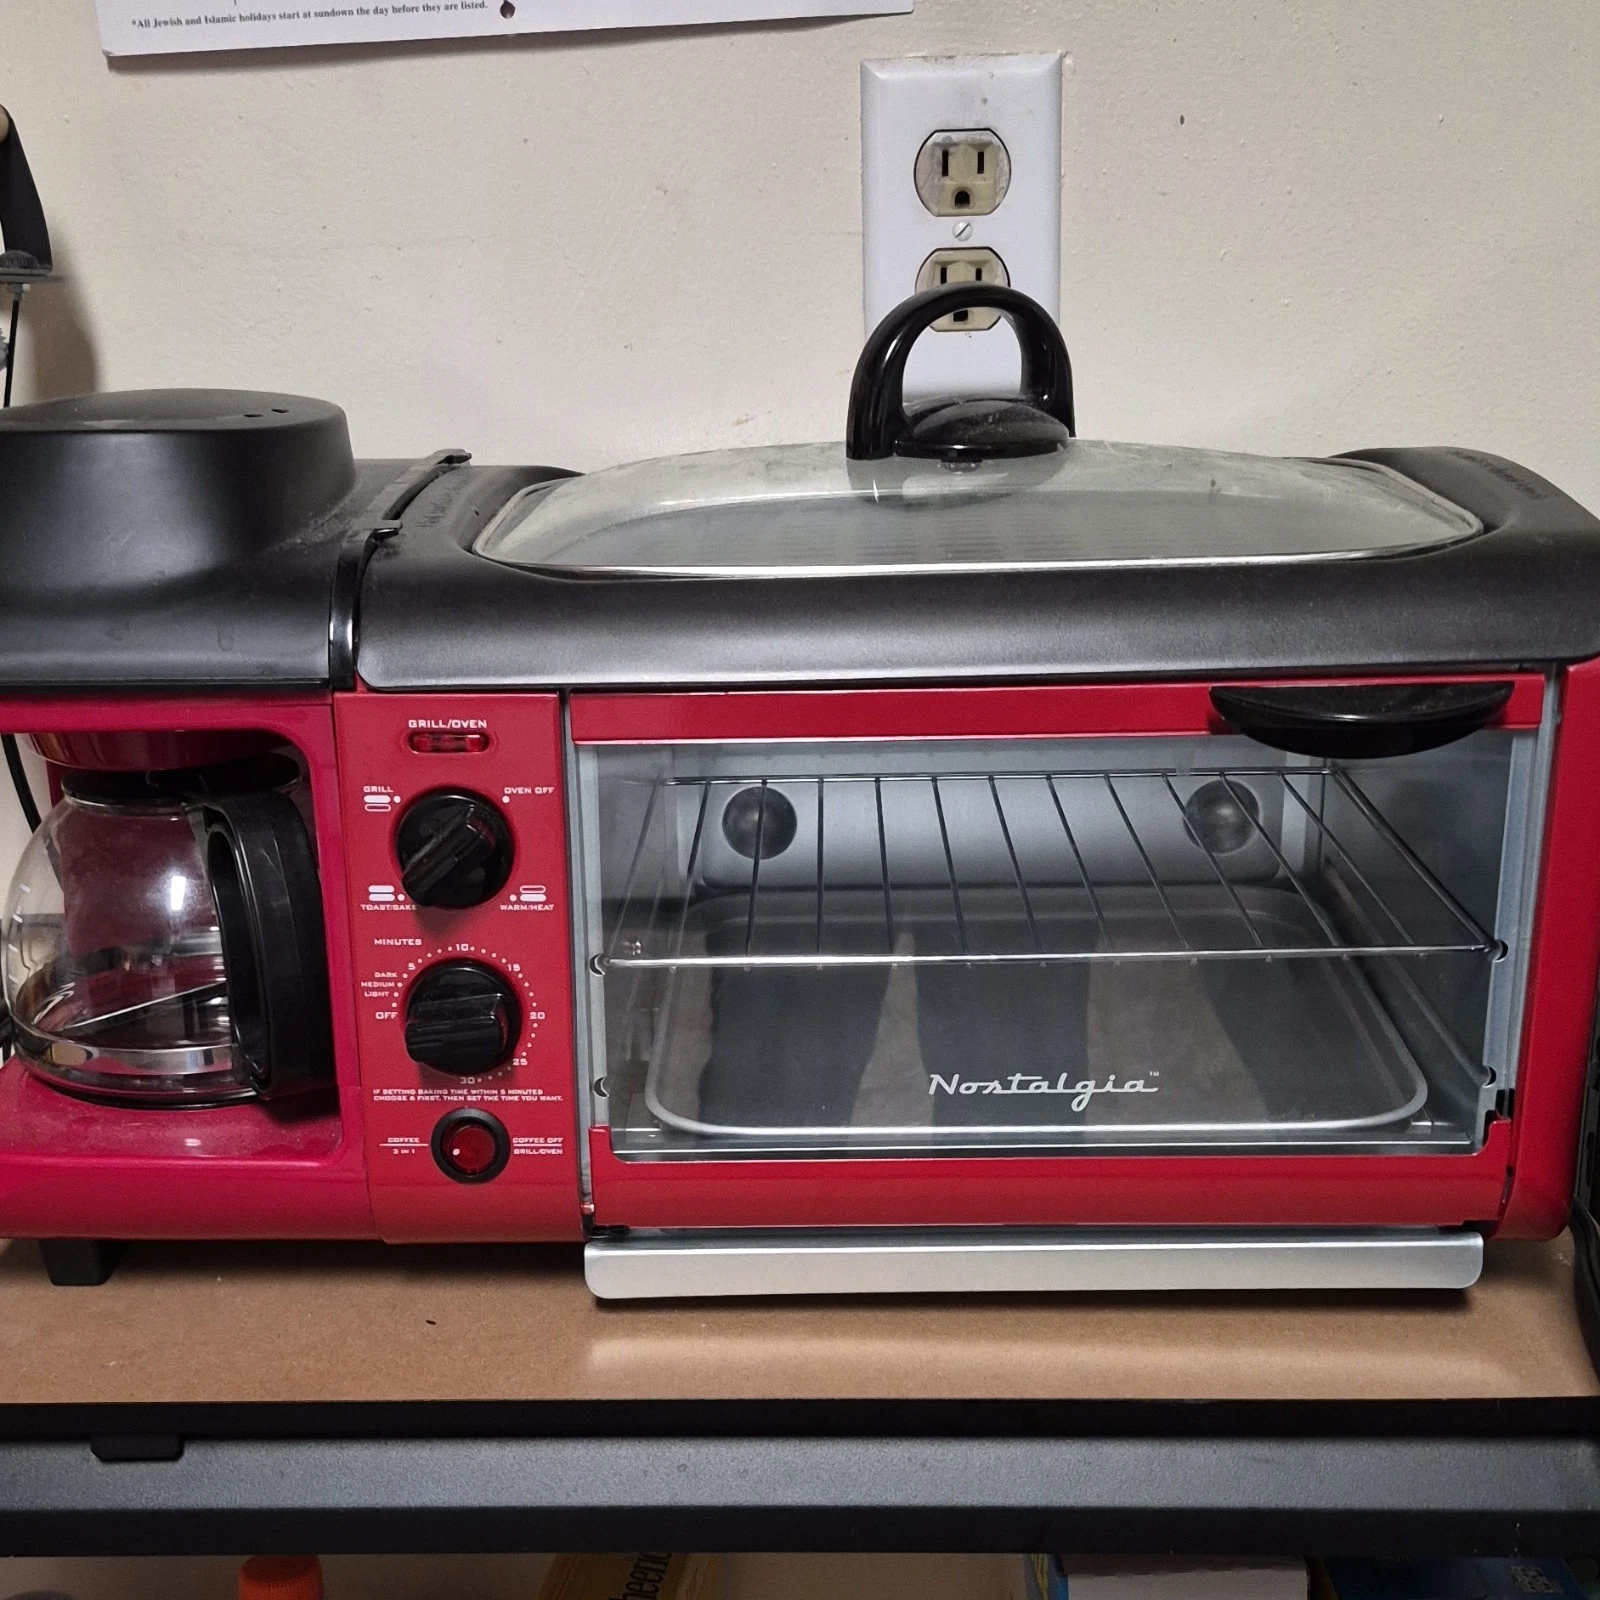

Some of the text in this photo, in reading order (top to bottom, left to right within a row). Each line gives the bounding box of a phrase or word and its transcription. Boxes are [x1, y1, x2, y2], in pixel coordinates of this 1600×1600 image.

[153, 17, 183, 28] Jewish
[185, 15, 202, 26] and
[204, 14, 237, 24] Islamic
[239, 12, 277, 23] holidays
[278, 11, 300, 20] start
[302, 11, 311, 19] at
[313, 8, 354, 18] sundown
[356, 6, 370, 16] the
[372, 6, 389, 16] day
[391, 4, 420, 14] before
[422, 3, 441, 13] they
[443, 3, 459, 11] are
[460, 0, 489, 10] listed.
[408, 719, 488, 729] GRILL/OVEN
[363, 785, 395, 793] GRILL
[503, 786, 555, 795] OVEN OFF
[373, 938, 423, 946] MINUTES
[455, 943, 469, 952] 10
[407, 962, 416, 970] 5
[507, 963, 521, 972] 15
[375, 1011, 399, 1020] OFF
[529, 1011, 546, 1020] 20
[512, 1058, 528, 1066] 25
[460, 1076, 476, 1085] 30
[928, 1073, 1159, 1112] Nostalgia
